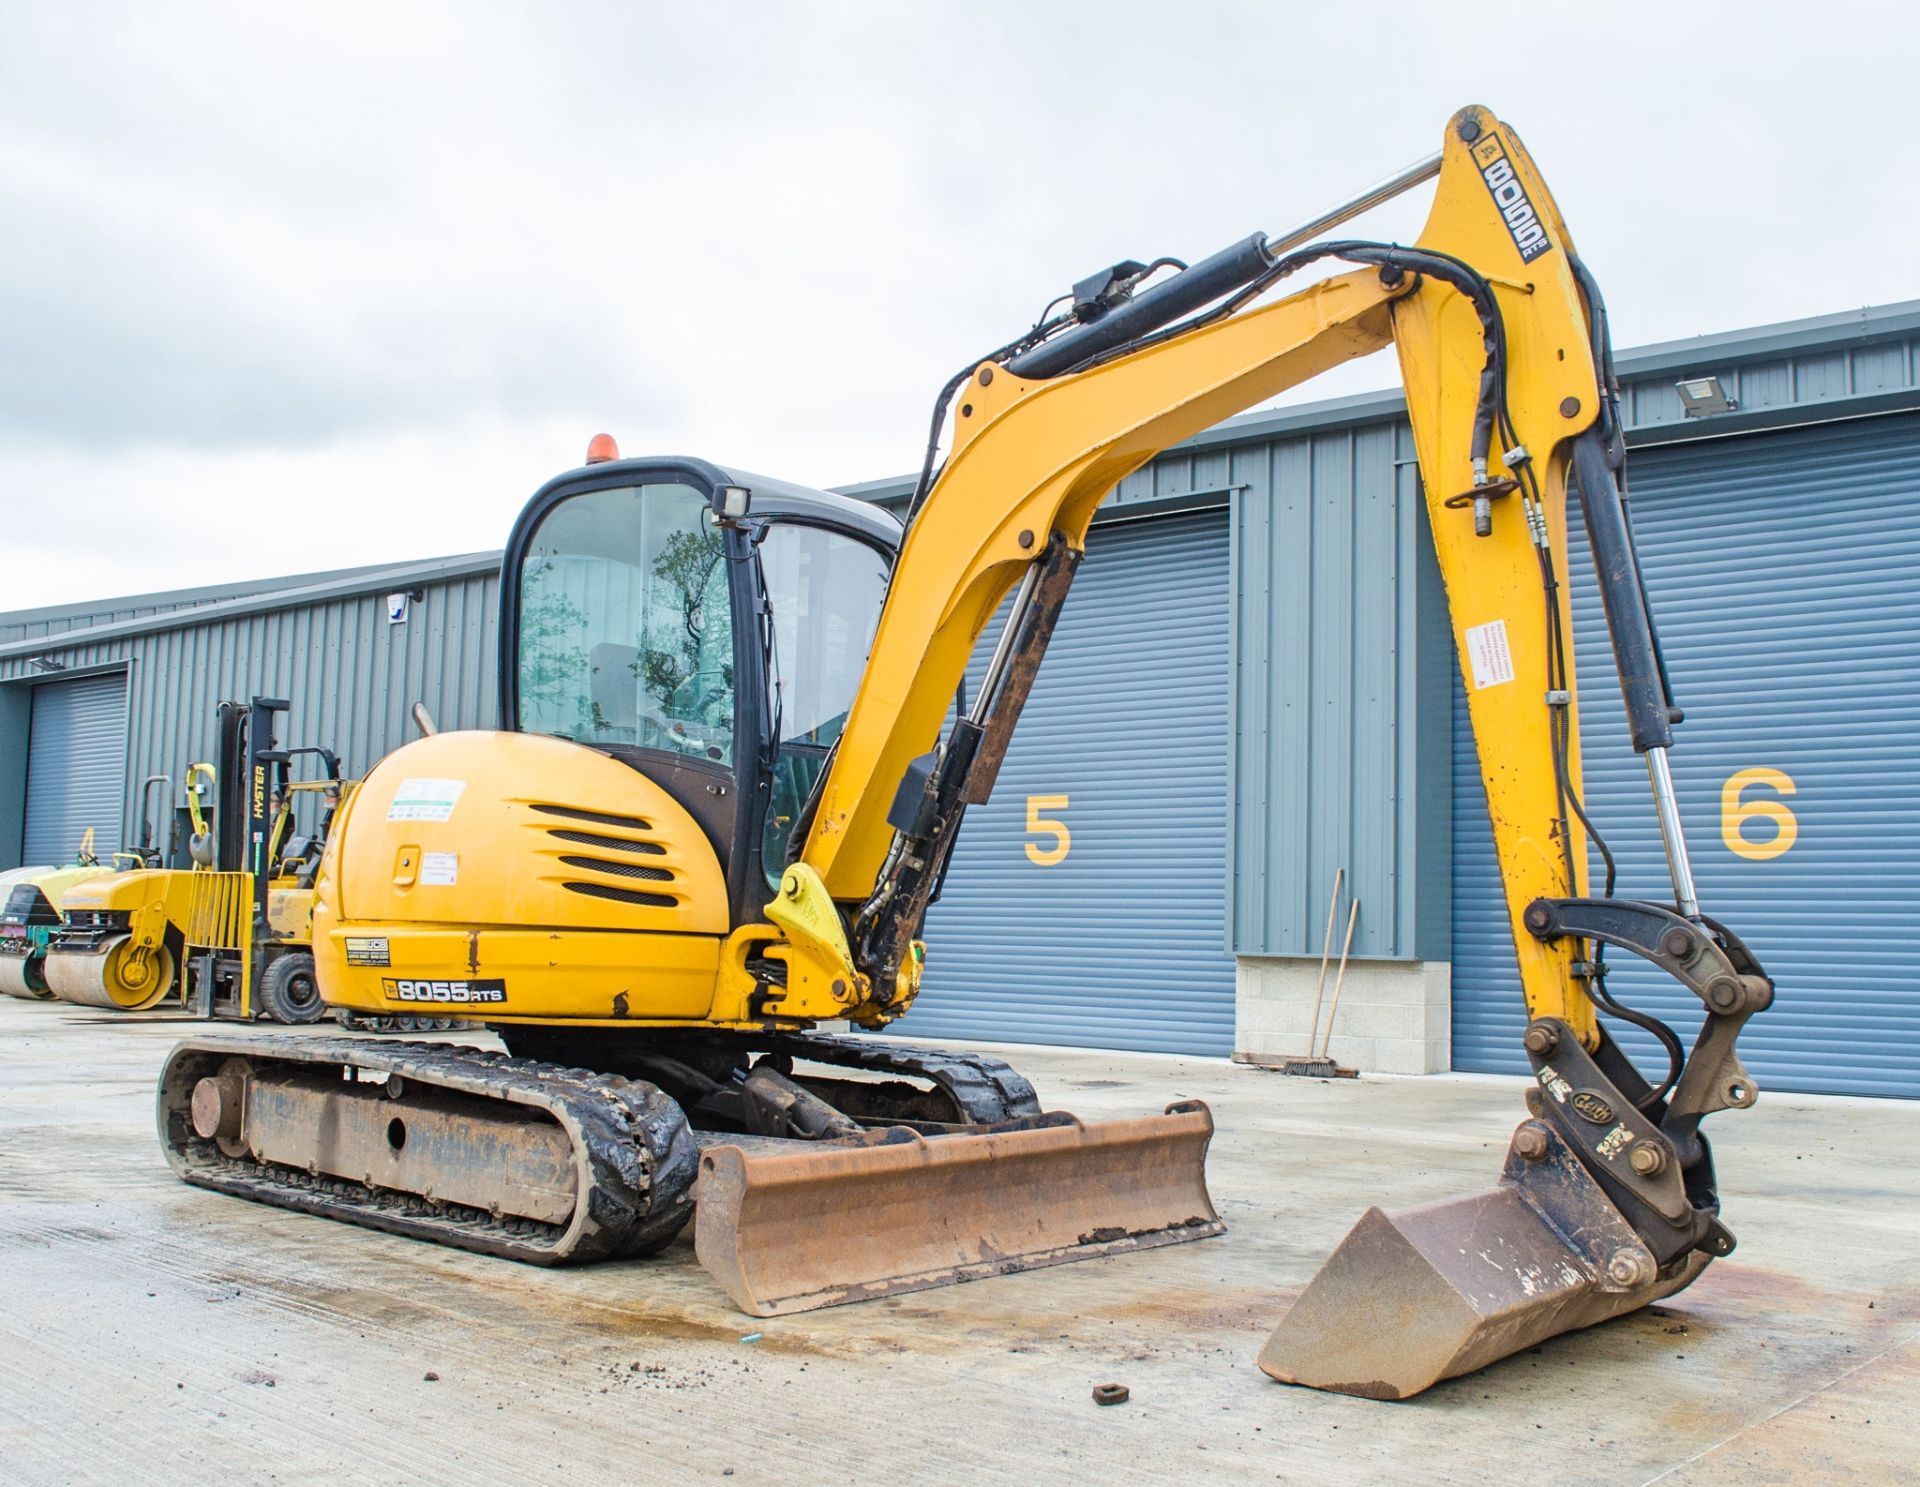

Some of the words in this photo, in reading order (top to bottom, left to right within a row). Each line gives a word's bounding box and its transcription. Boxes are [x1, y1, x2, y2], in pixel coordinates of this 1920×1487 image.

[1484, 158, 1544, 248] 8055
[254, 765, 264, 819] HYSTER
[1024, 794, 1071, 867] 5
[1721, 767, 1798, 860] 6
